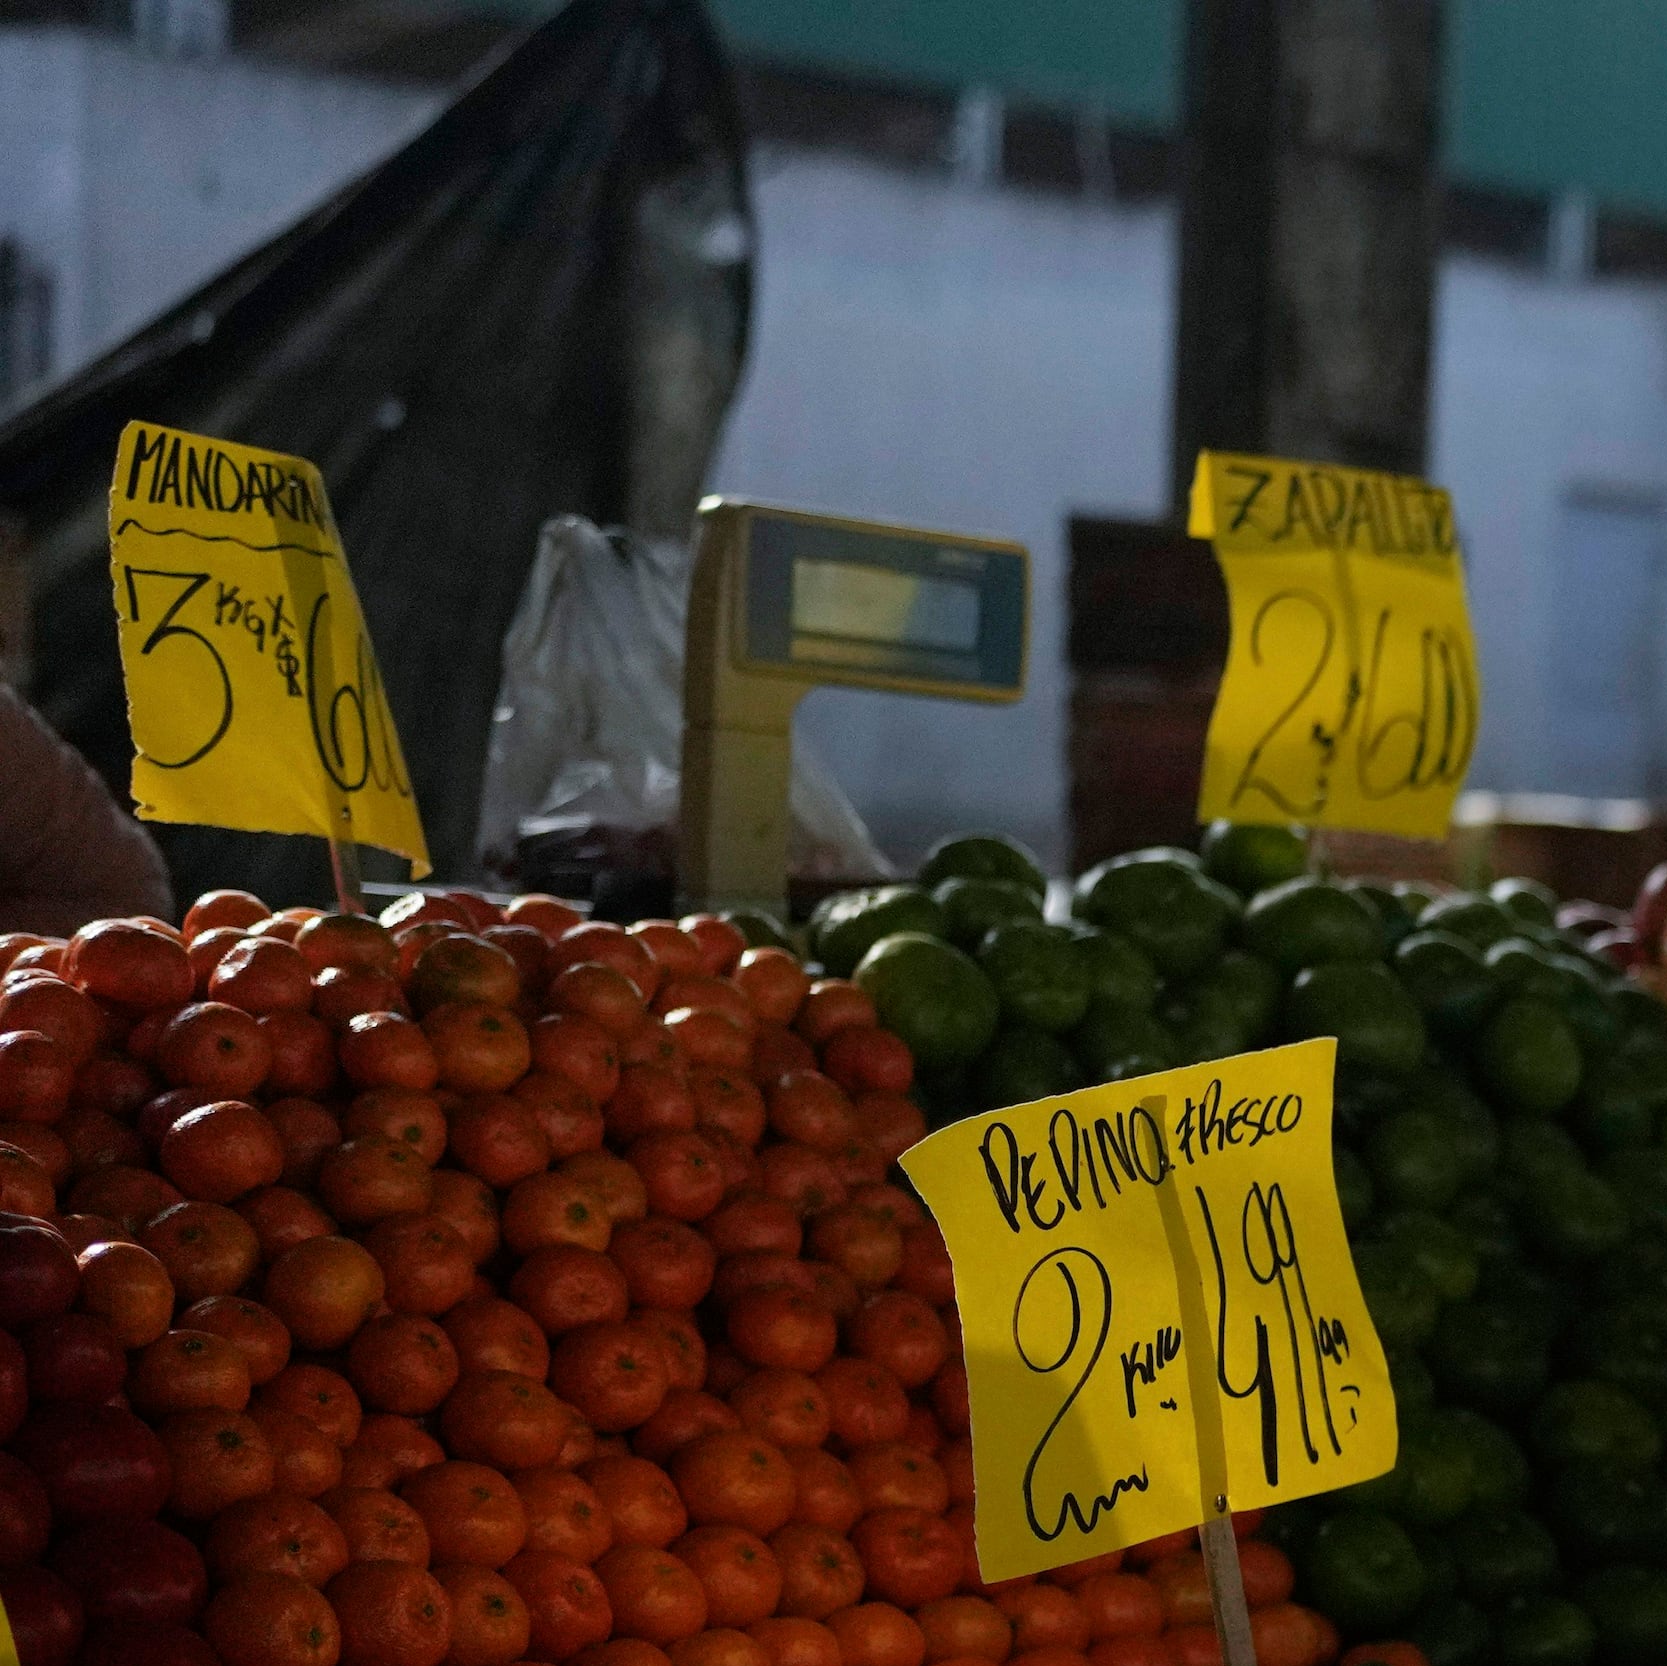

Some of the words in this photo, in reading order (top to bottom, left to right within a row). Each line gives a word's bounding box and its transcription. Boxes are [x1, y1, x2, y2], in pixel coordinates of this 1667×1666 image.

[124, 565, 234, 769] 3
[1176, 1079, 1302, 1164] FRESCO
[1012, 1246, 1149, 1542] 2
